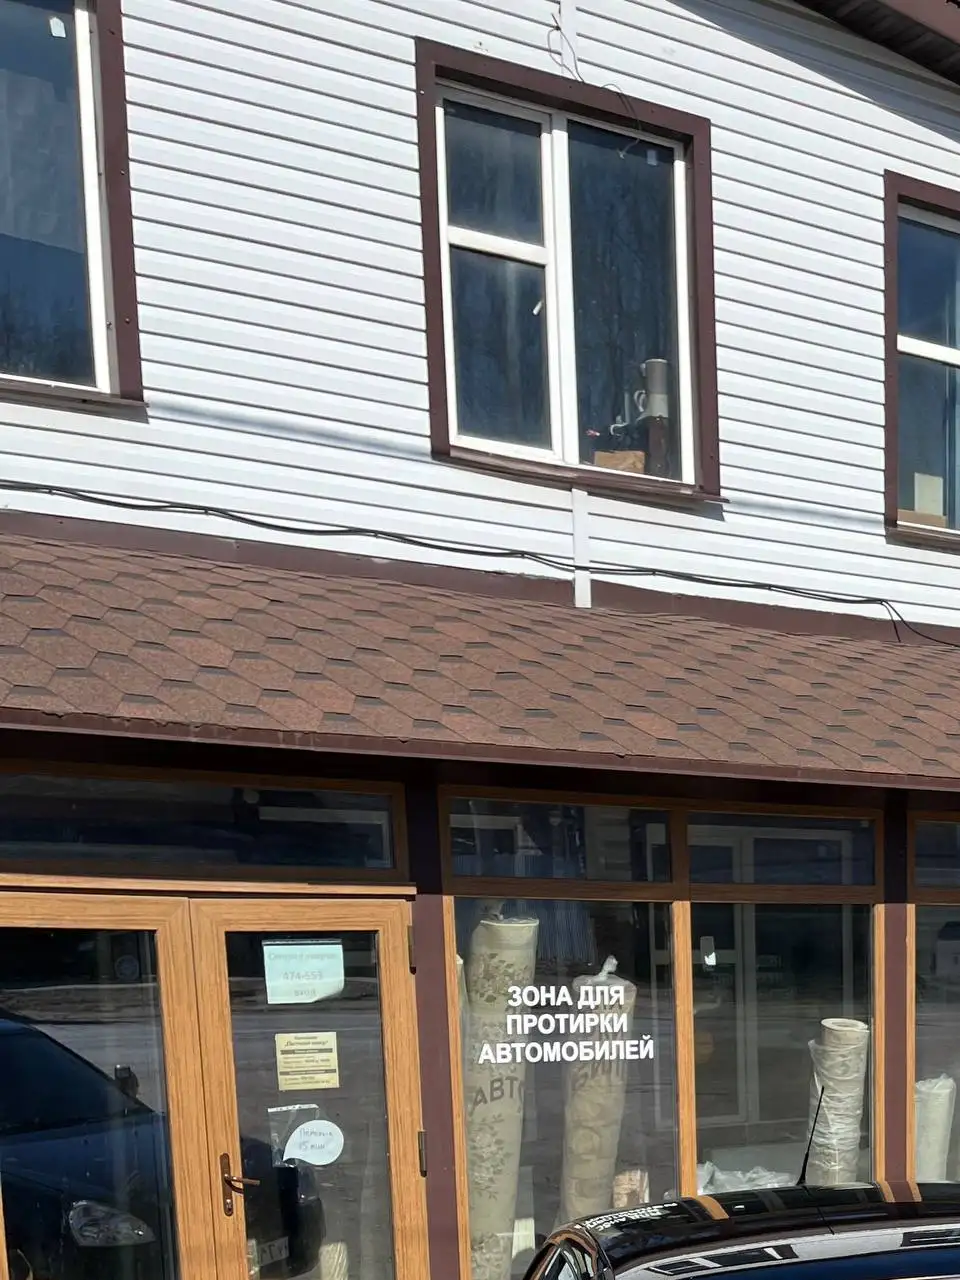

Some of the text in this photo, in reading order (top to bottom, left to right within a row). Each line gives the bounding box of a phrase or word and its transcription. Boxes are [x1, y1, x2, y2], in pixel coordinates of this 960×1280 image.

[507, 985, 625, 1009] ЗОНА ДЛЯ
[506, 1013, 627, 1035] ПРОТИРКИ
[478, 1035, 654, 1064] АВТОМОБИЛЕЙ
